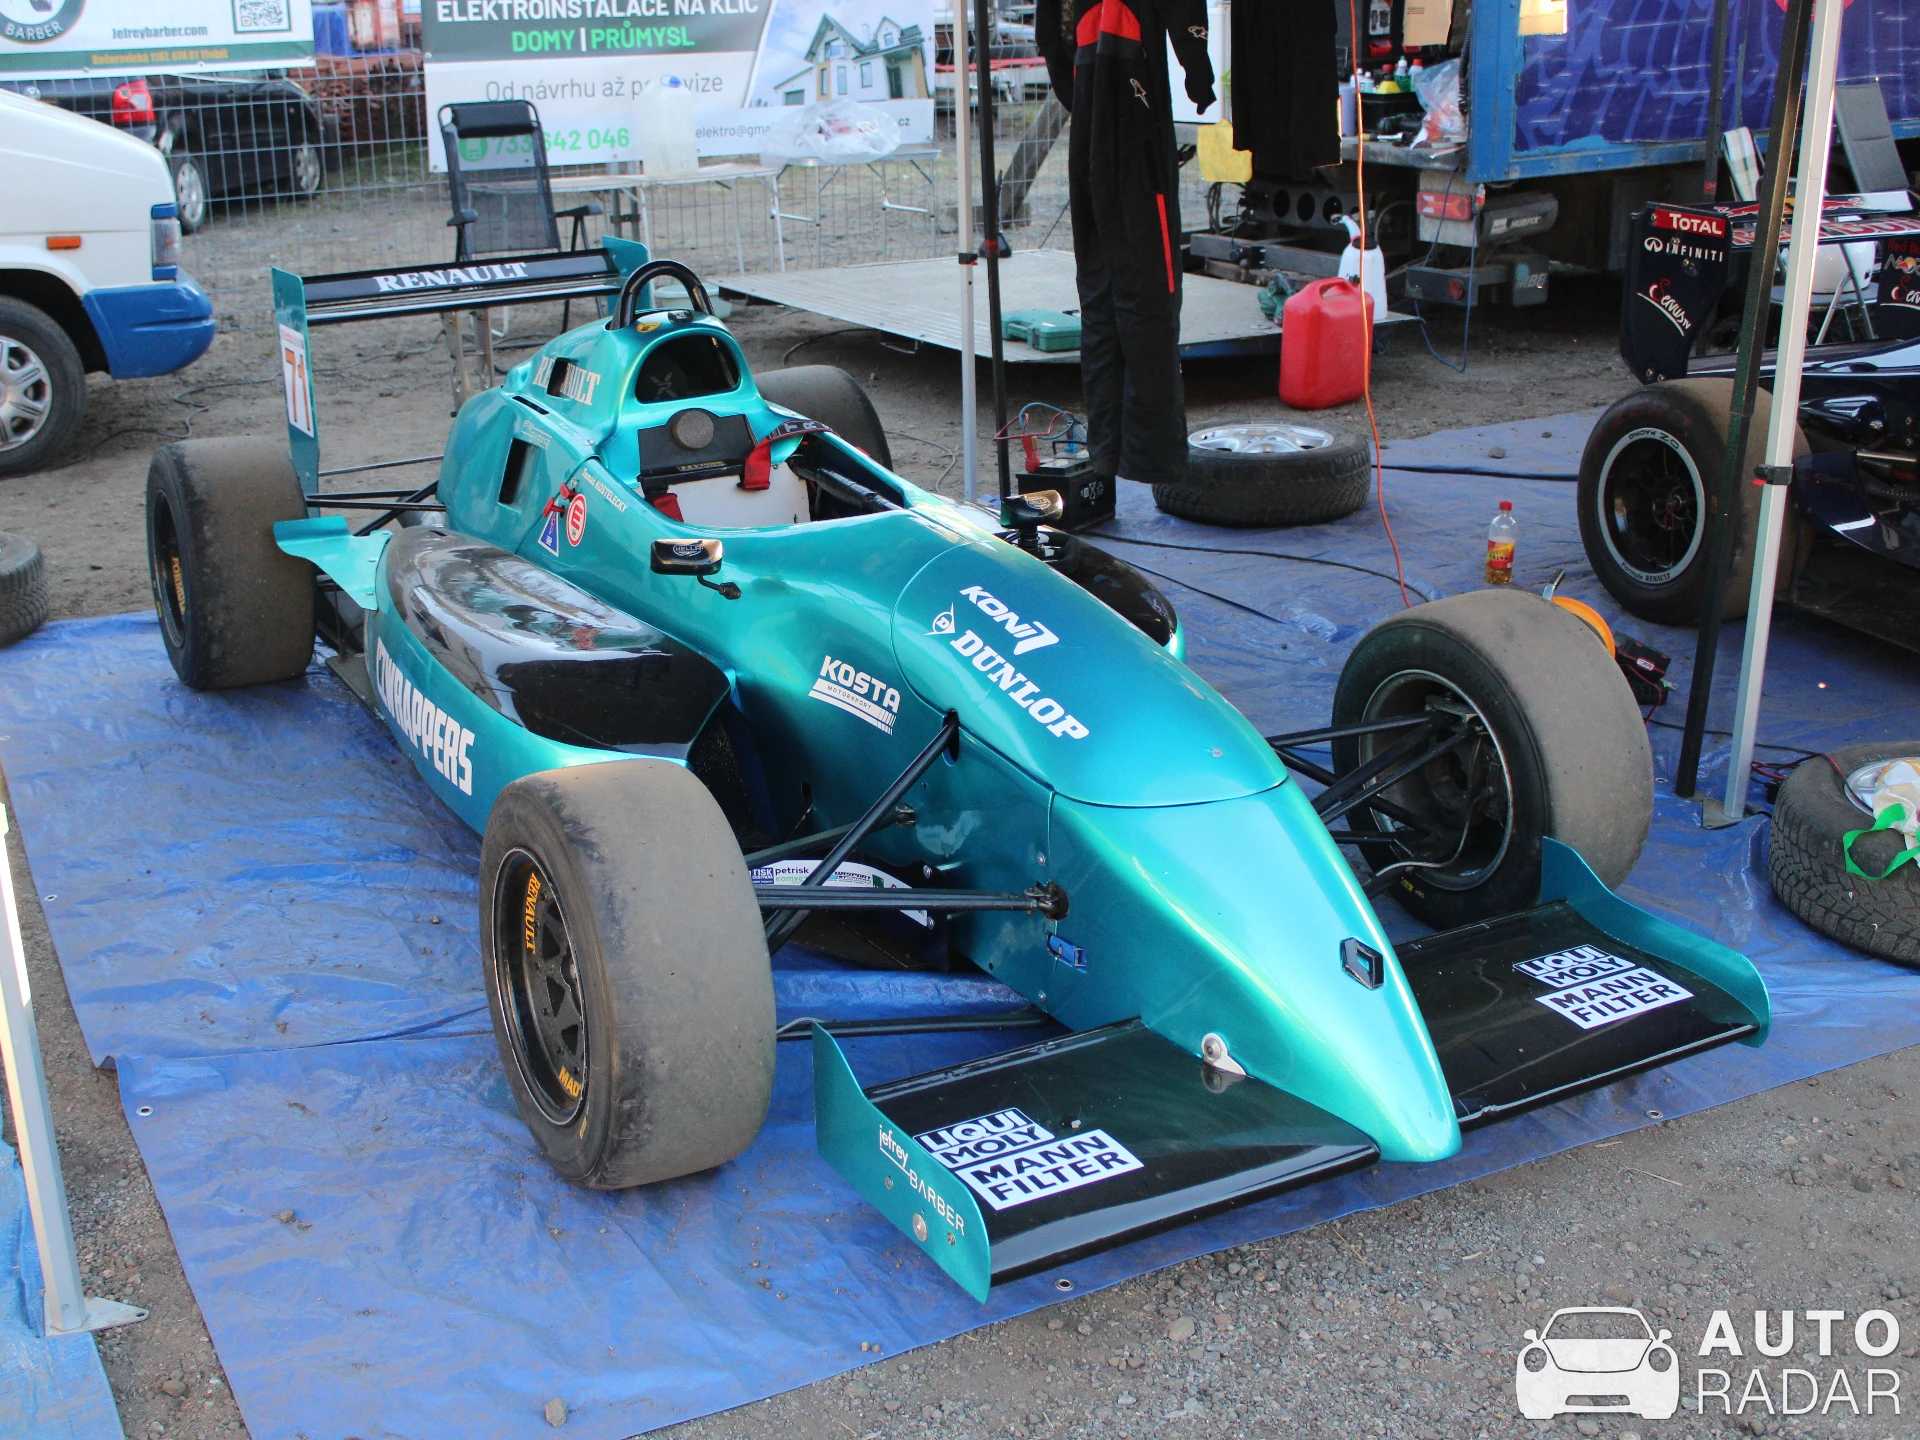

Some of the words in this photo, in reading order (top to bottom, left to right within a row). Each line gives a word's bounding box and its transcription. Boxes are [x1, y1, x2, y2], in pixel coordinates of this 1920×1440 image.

[437, 0, 669, 22] ELEKTROINSTALACE
[674, 0, 706, 16] NA
[5, 20, 64, 40] BARBER
[511, 29, 576, 52] DOMY
[591, 20, 696, 49] PRŮMYSL
[486, 80, 515, 101] Od
[523, 76, 597, 100] návrhu
[602, 75, 625, 97] až
[684, 74, 724, 93] vize
[587, 128, 630, 149] 046
[1669, 213, 1722, 235] TOTAL
[1665, 242, 1723, 262] INFINITI
[373, 262, 529, 292] RENAULT
[284, 347, 311, 432] 71
[532, 356, 601, 405] REAULT
[595, 481, 628, 513] KOSTELECKÝ
[820, 655, 901, 713] KOSTA
[827, 685, 872, 709] MOTORSPORT
[950, 629, 1090, 740] DUNLOP
[775, 867, 809, 876] petrisk
[525, 873, 541, 957] RENAULT
[1519, 947, 1605, 976] LIQUI
[1543, 957, 1624, 985] MOLY
[1548, 972, 1658, 1009] MANN
[1570, 984, 1682, 1022] FILTER
[915, 1109, 1028, 1153] LIQUI
[949, 1126, 1046, 1166] MOLY
[971, 1135, 1110, 1184] MANN
[879, 1125, 909, 1164] jefrey
[909, 1171, 965, 1236] BARBER
[988, 1151, 1138, 1201] FILTER
